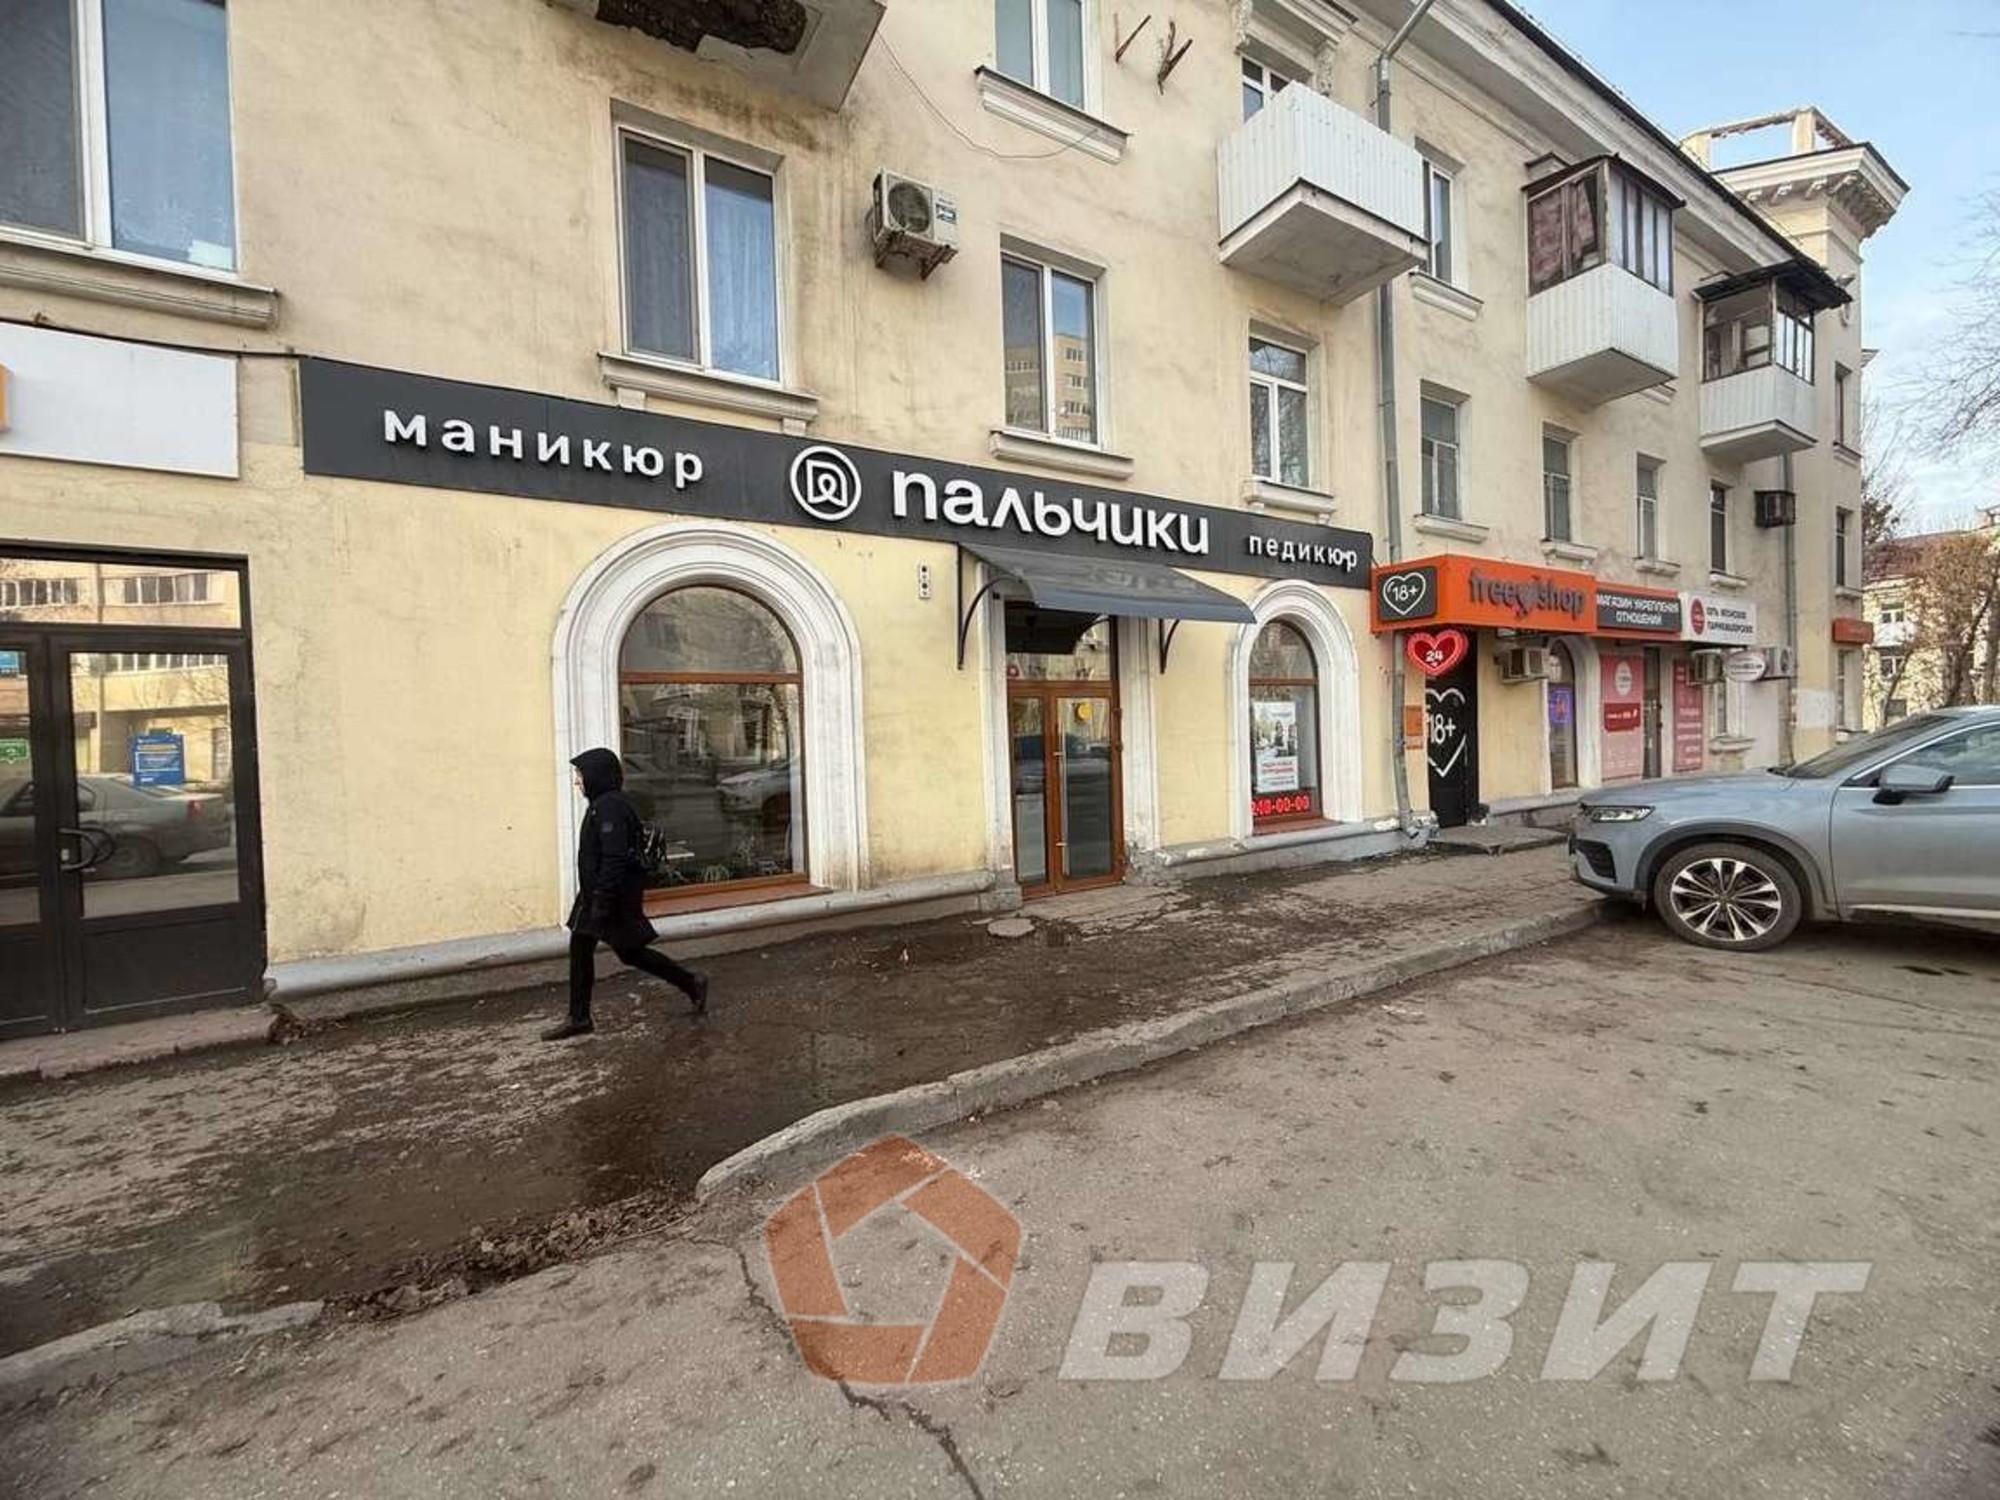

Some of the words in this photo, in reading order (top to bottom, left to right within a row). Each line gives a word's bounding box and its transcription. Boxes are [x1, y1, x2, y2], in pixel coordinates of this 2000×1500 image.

[383, 409, 704, 489] маникюр
[892, 469, 1210, 556] пальчики
[1248, 533, 1359, 570] педикюр
[1391, 585, 1418, 602] 18+
[1425, 650, 1443, 662] 24
[1424, 713, 1456, 744] 18+
